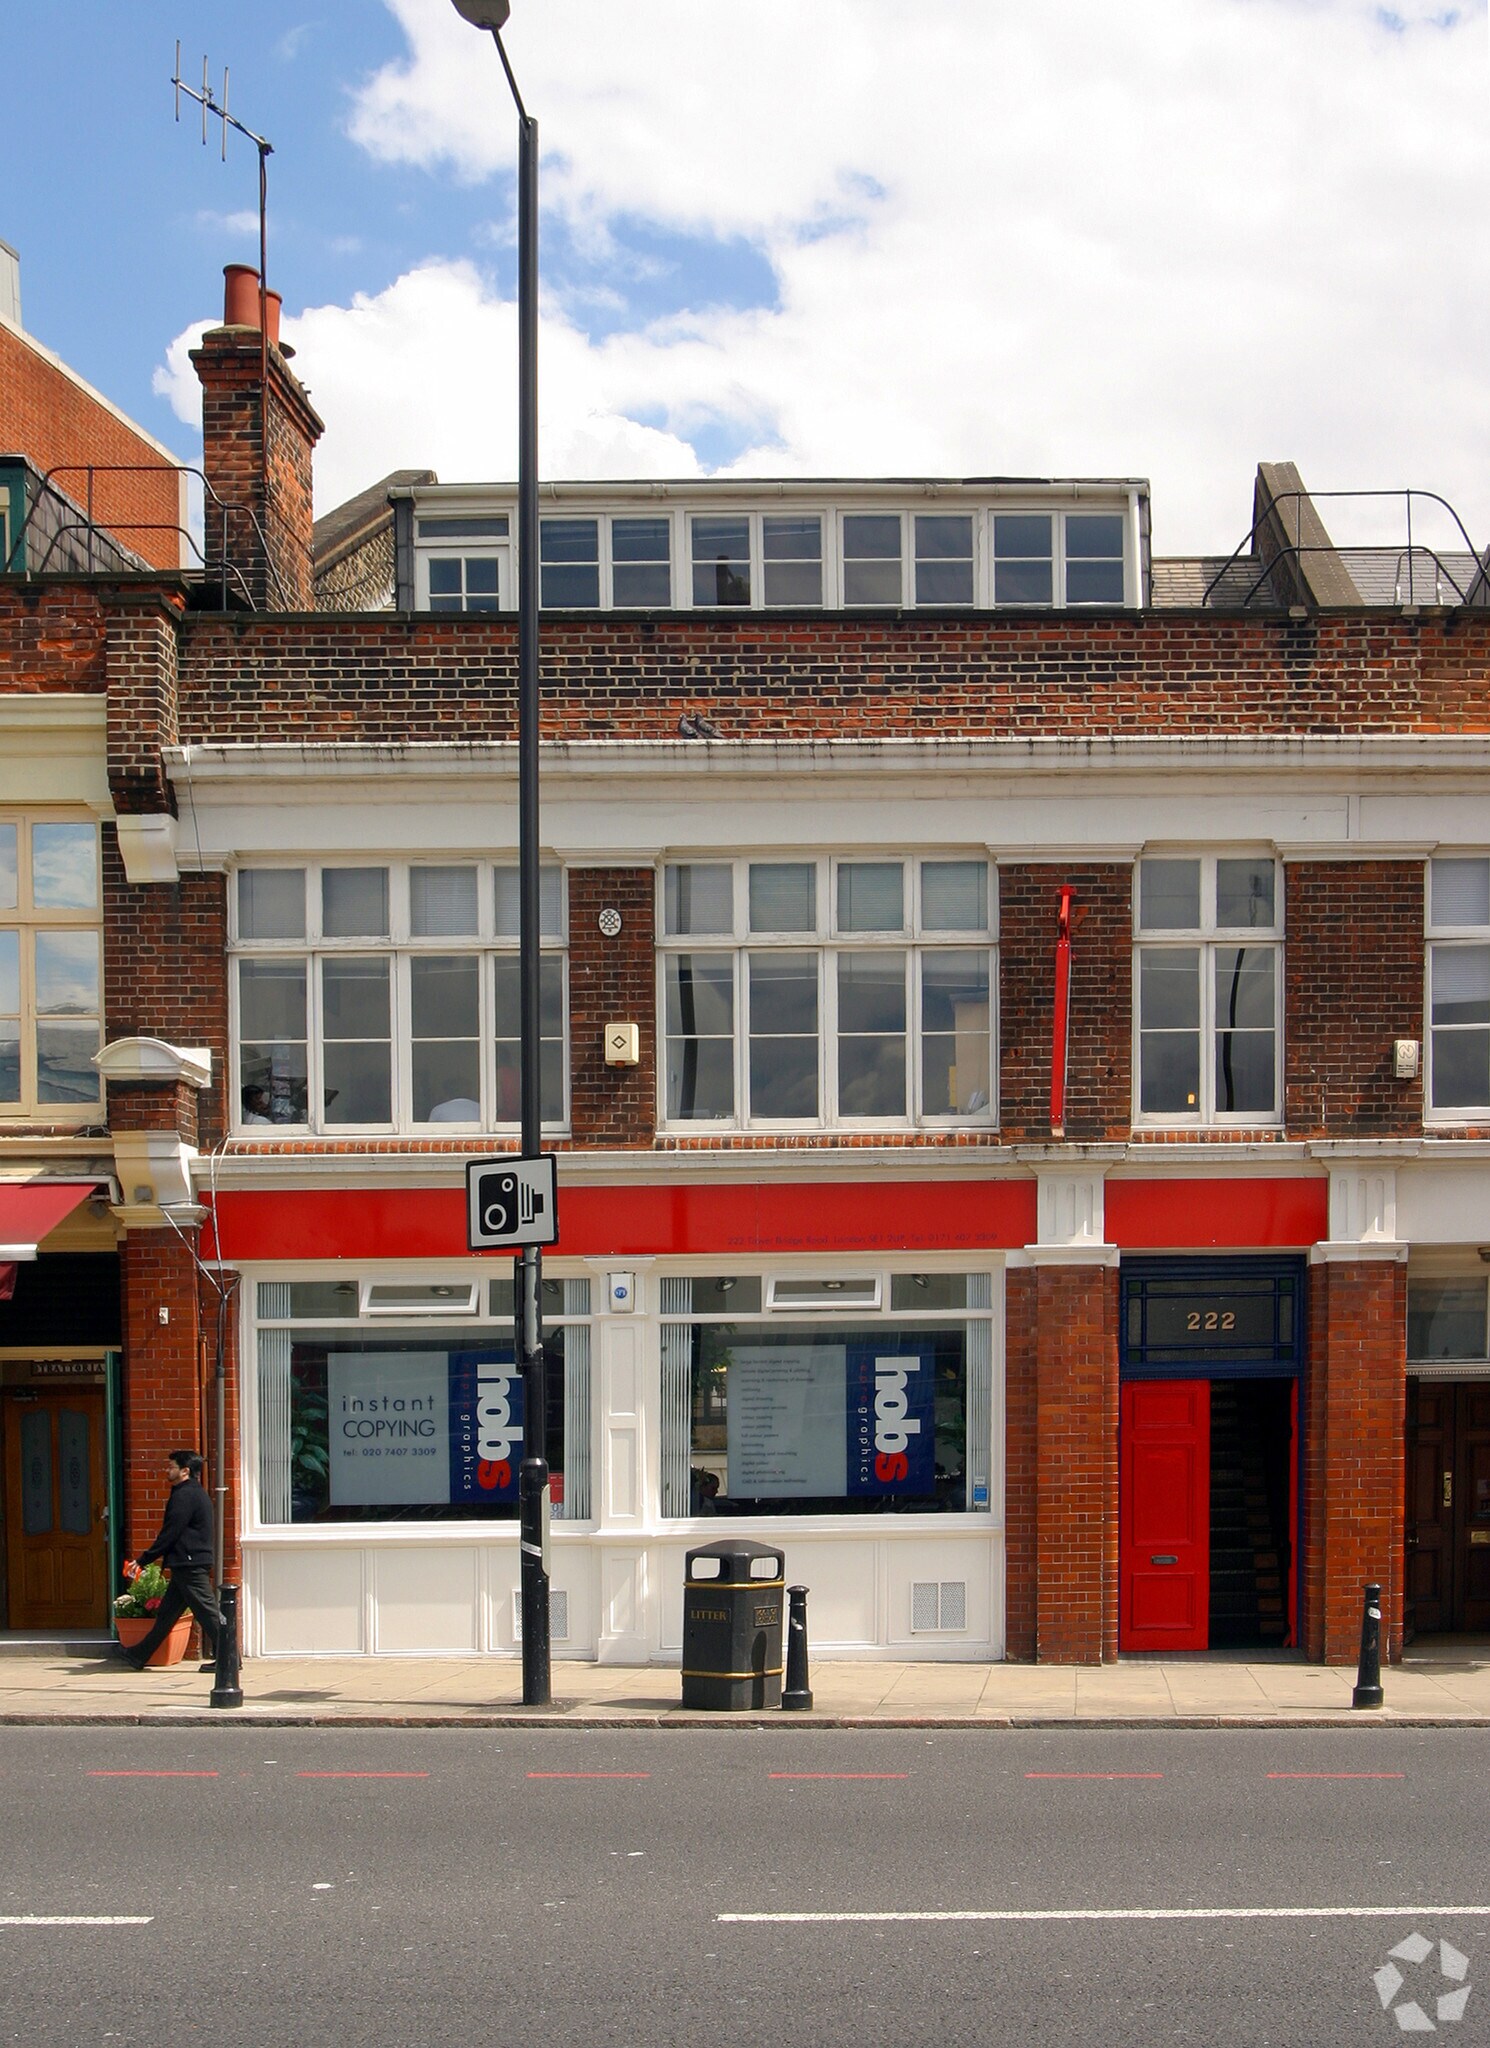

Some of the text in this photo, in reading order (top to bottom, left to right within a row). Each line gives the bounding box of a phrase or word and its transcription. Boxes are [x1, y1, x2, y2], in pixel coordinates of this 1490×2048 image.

[775, 1235, 803, 1247] Bridge
[1187, 1312, 1236, 1330] 222
[343, 1395, 434, 1412] instant
[476, 1363, 524, 1490] hobs
[874, 1356, 921, 1483] hobs
[343, 1419, 435, 1438] COPYING
[343, 1447, 437, 1457] tel: 020 7407 3309
[690, 1610, 727, 1621] LITTER
